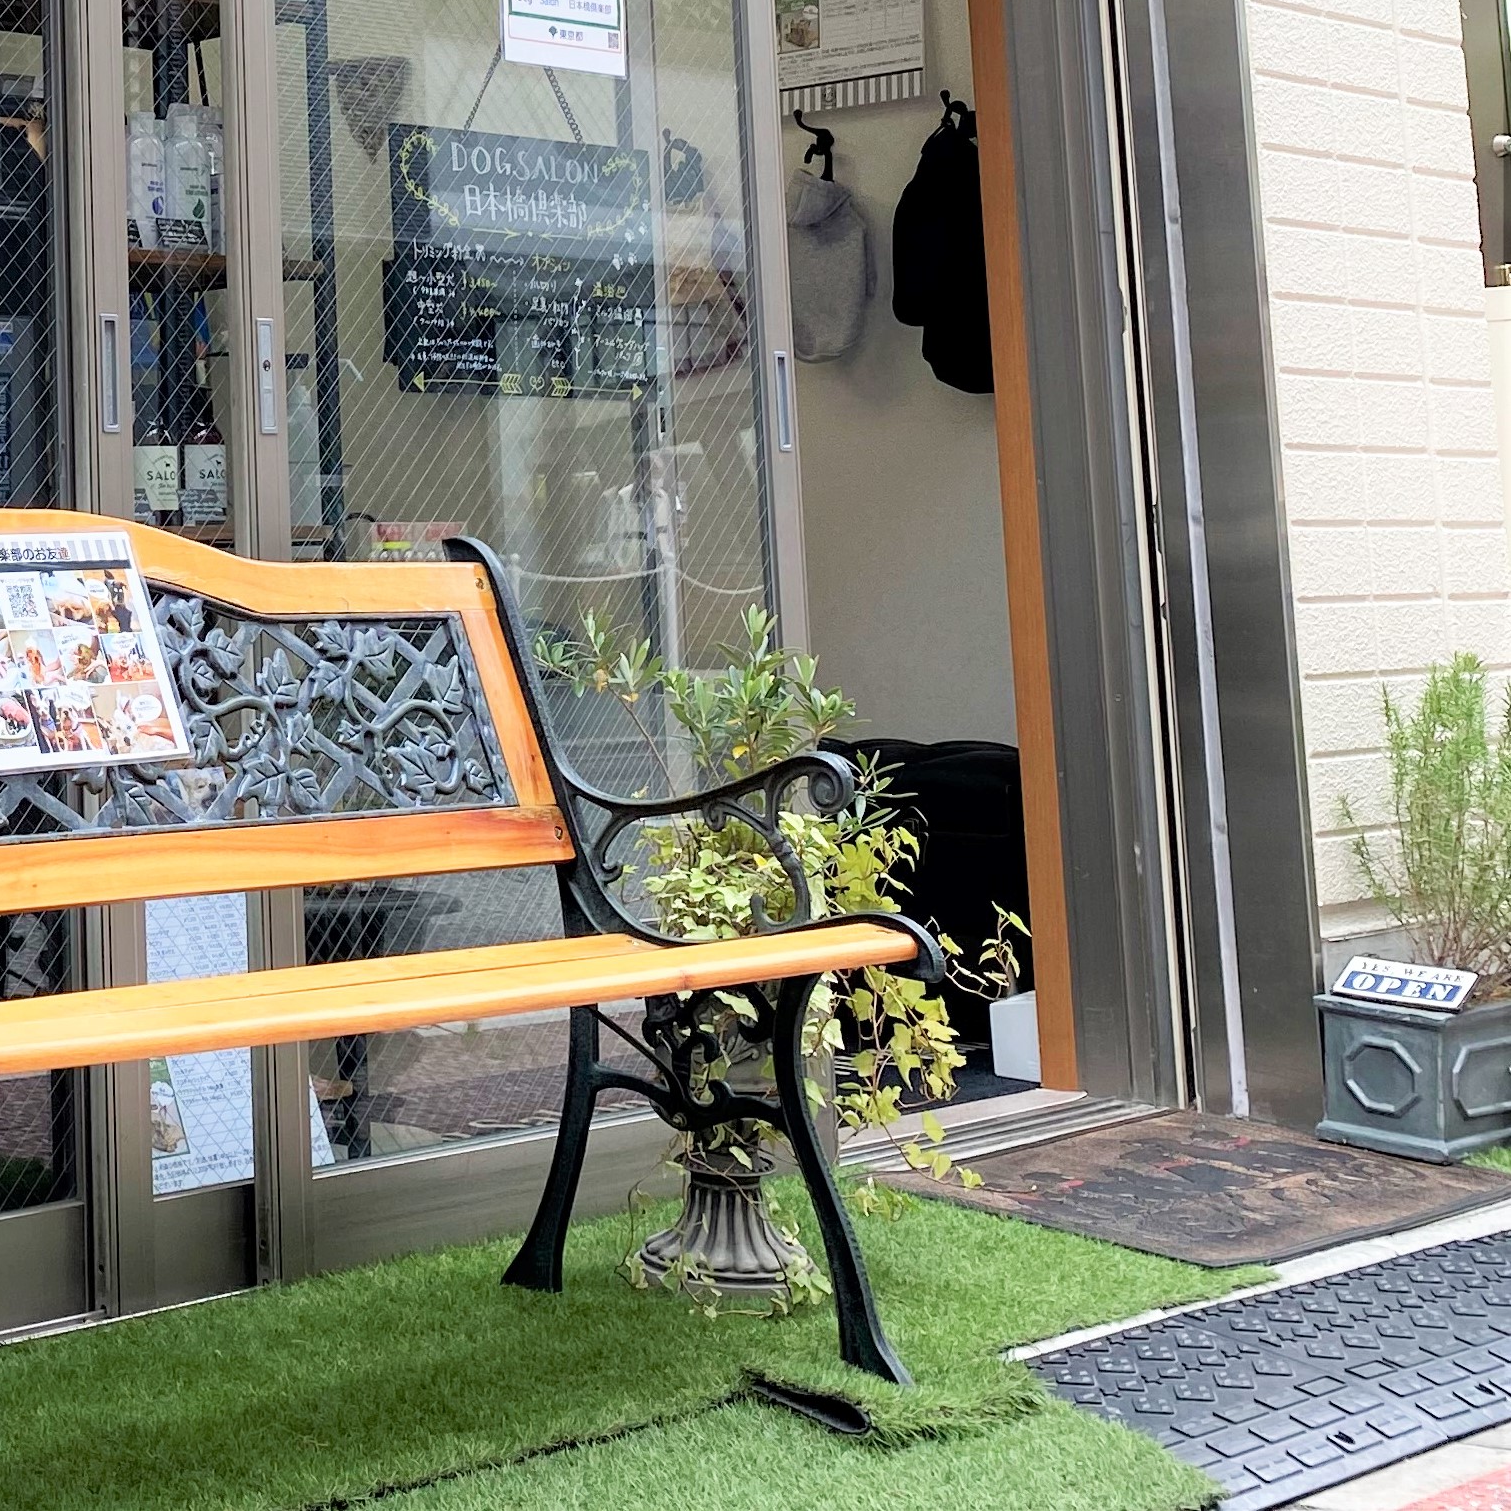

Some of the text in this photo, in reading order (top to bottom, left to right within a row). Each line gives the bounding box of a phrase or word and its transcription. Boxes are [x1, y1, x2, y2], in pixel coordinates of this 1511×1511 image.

[450, 141, 599, 184] DOG SALON
[1352, 973, 1454, 1001] OPEN
[1404, 968, 1428, 978] WE
[1431, 973, 1465, 983] ARE
